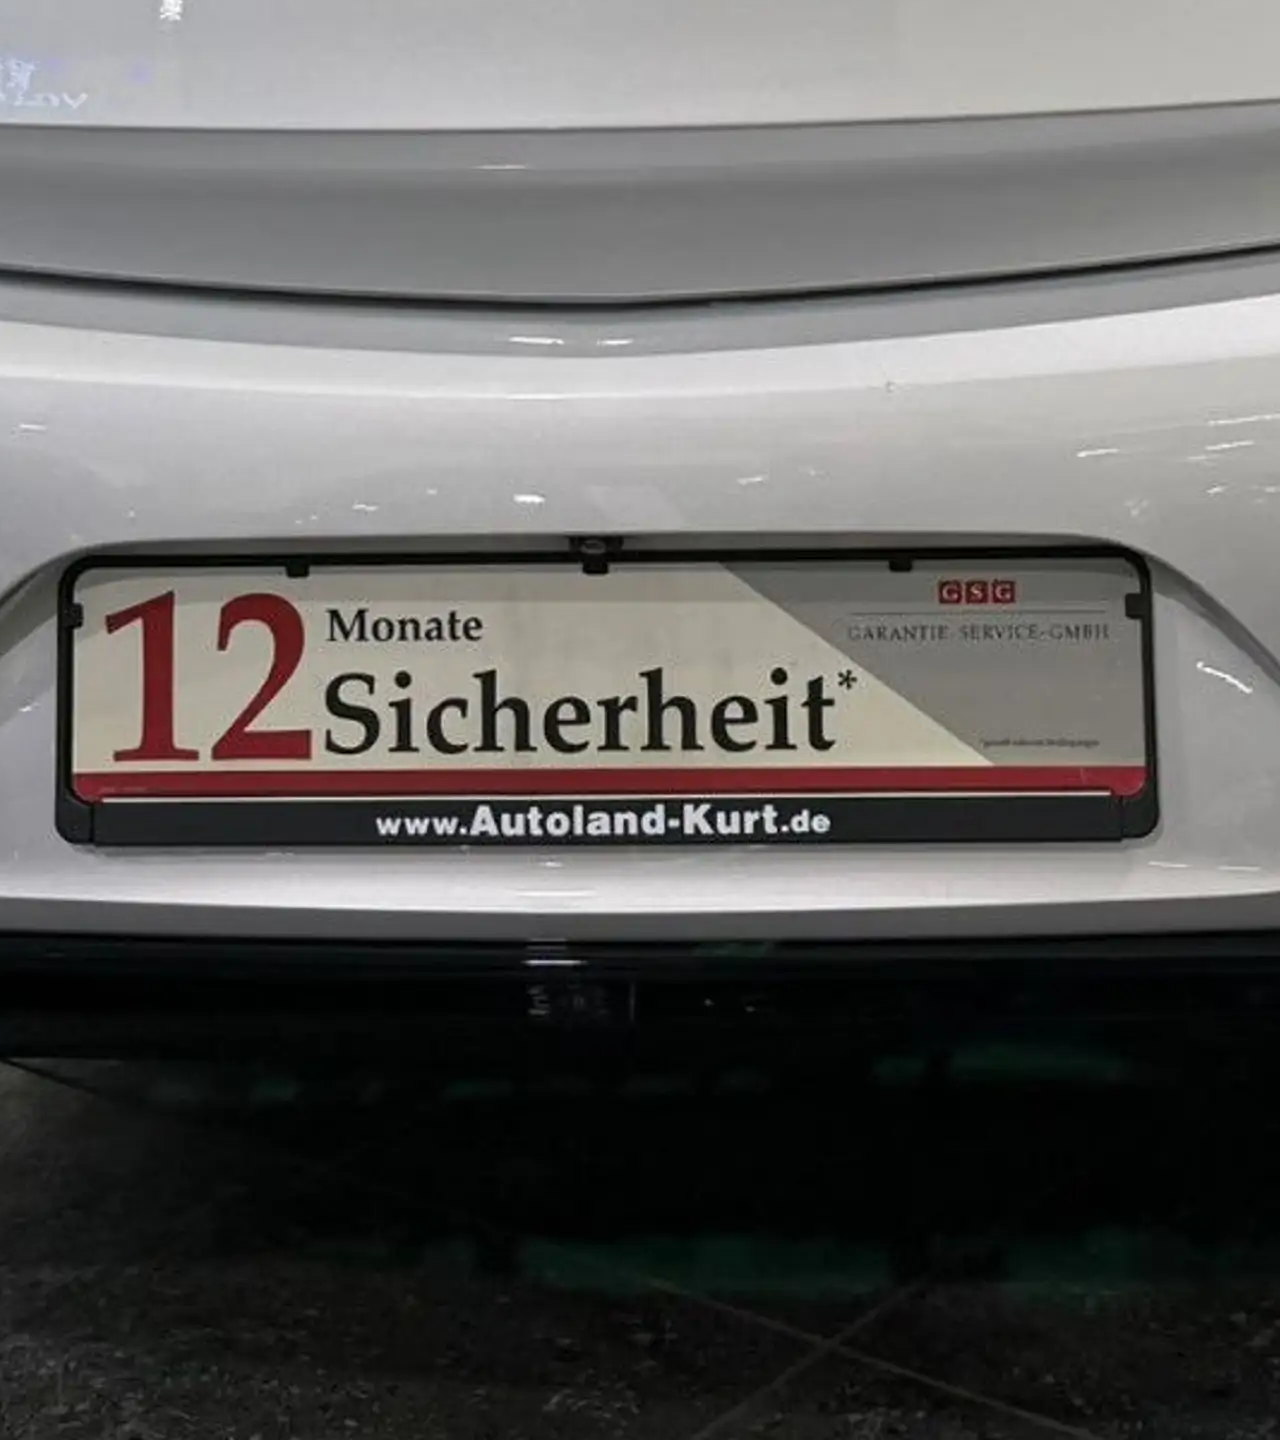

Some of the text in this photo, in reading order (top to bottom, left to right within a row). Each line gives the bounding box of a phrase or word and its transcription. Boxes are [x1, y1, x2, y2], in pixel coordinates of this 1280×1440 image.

[940, 581, 1015, 603] GSG
[325, 608, 483, 643] Monate
[105, 590, 312, 761] 12
[375, 804, 831, 838] www.Autoland-Kurt.de
